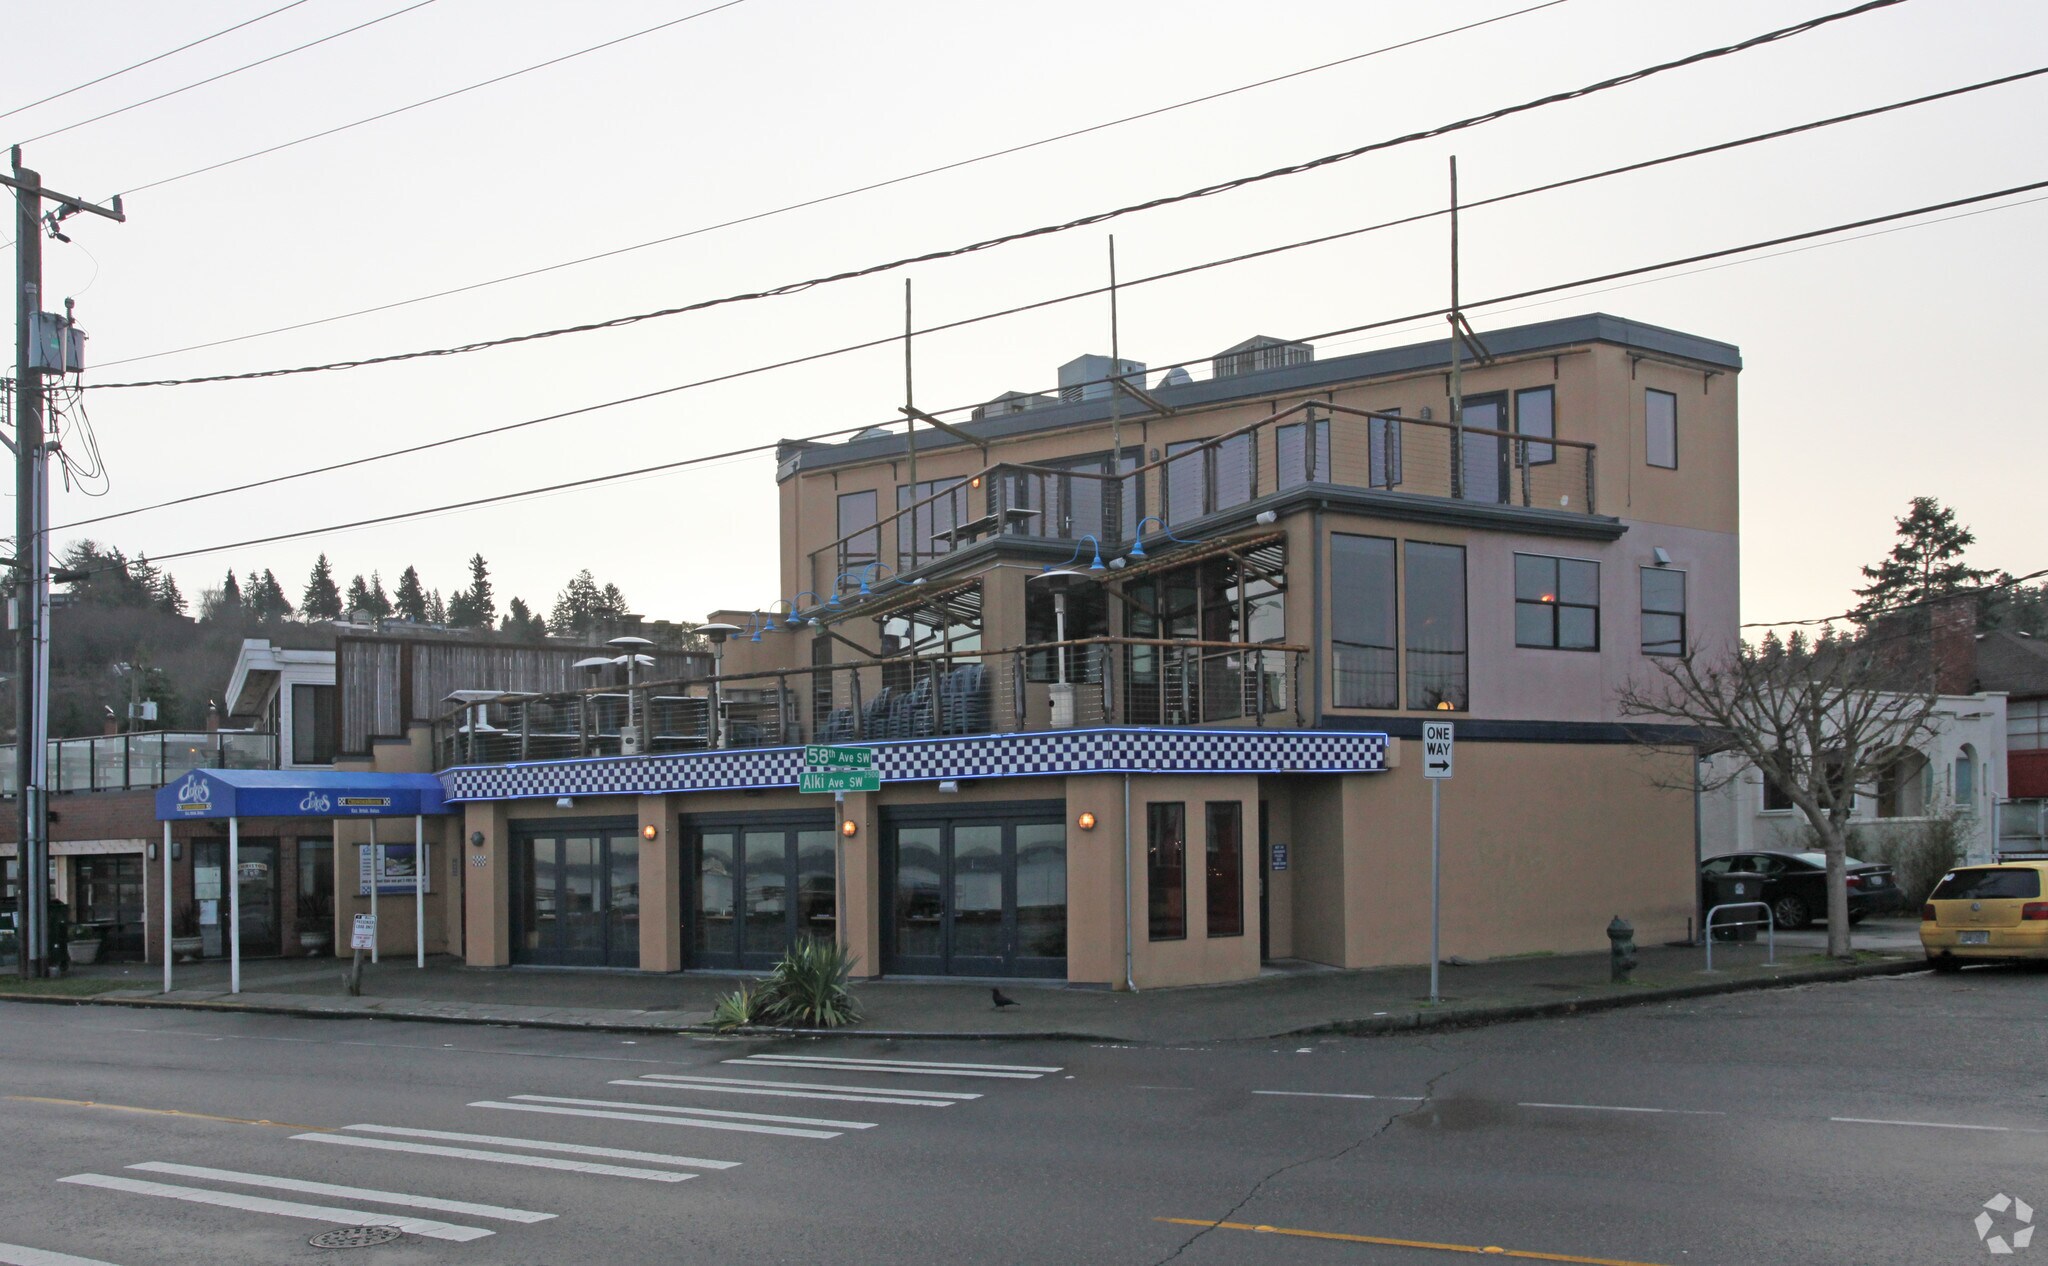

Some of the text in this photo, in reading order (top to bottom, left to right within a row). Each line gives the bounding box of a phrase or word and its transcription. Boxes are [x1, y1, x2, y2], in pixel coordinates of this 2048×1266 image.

[1427, 727, 1450, 740] ONE
[808, 748, 870, 764] 58th Ave SW
[1427, 743, 1450, 755] WAY
[803, 774, 863, 789] Alki Ave SW
